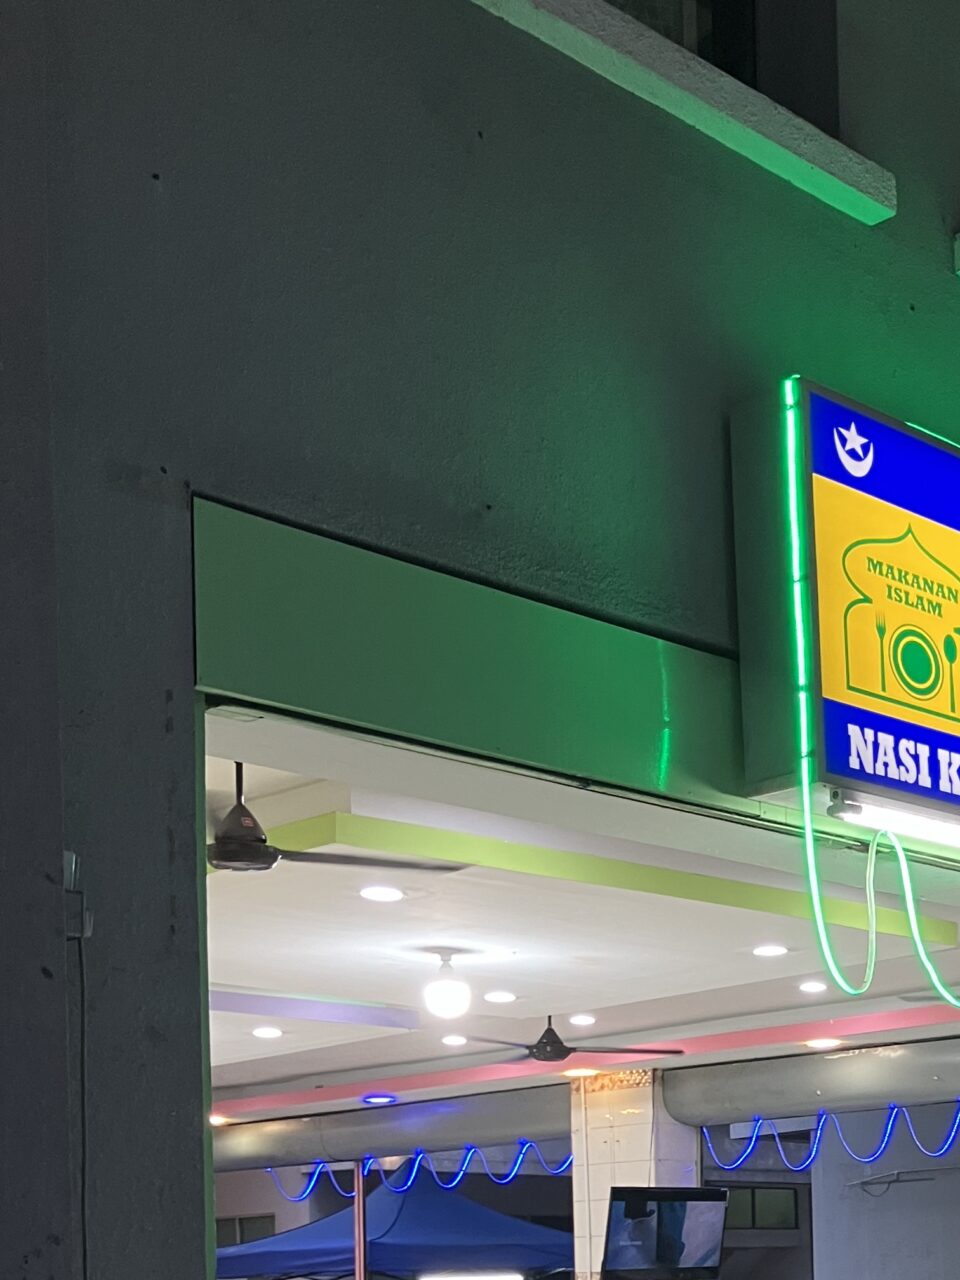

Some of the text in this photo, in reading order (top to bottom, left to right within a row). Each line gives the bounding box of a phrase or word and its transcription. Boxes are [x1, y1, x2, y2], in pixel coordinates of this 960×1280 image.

[866, 556, 959, 604] MAKANAN
[886, 584, 943, 618] ISLAM
[847, 723, 932, 789] NASI
